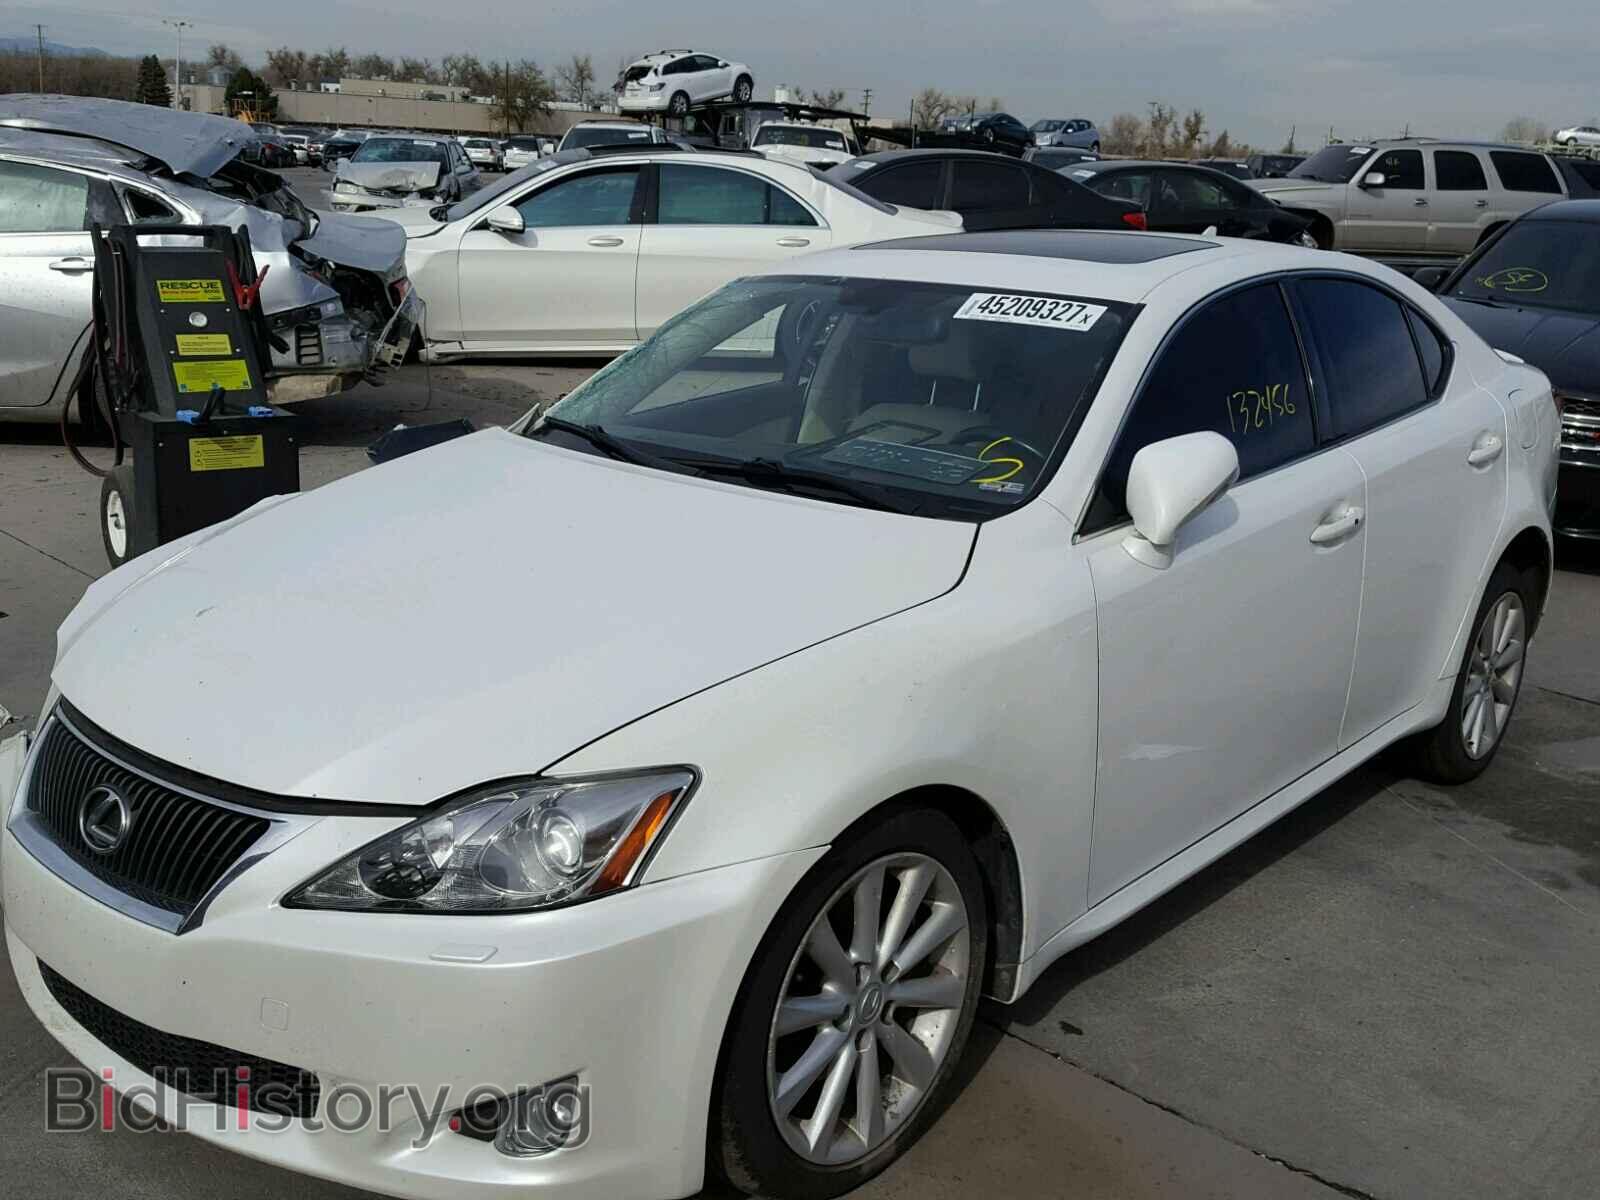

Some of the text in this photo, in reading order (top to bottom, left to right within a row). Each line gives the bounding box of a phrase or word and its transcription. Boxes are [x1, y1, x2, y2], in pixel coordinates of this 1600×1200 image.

[160, 281, 220, 289] RESCUE
[977, 295, 1088, 323] 45209327
[1226, 384, 1296, 434] 132456
